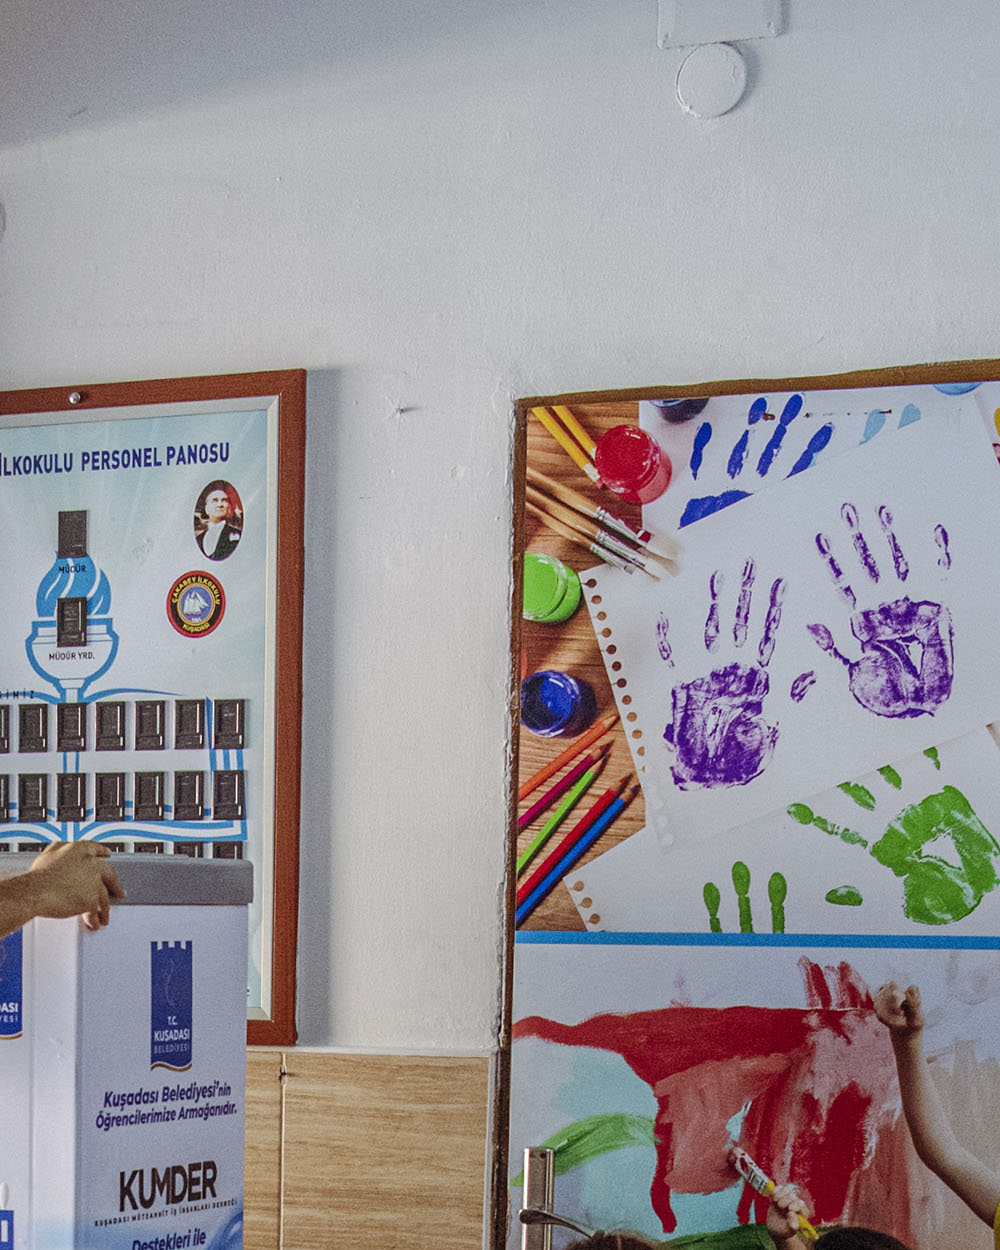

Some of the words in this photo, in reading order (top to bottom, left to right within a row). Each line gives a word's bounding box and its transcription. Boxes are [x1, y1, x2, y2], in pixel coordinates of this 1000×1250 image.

[81, 447, 163, 471] PERSONEL
[166, 442, 230, 466] PANOSU
[58, 564, 87, 574] MÜDÜR
[171, 576, 197, 603] ÇAKABEY
[48, 651, 77, 661] MÜDÜR
[77, 651, 96, 661] YRD.
[153, 1028, 191, 1043] KUŞADASI
[103, 1087, 160, 1112] Kuşadası
[95, 1106, 177, 1132] Öğrencilerimize
[177, 1100, 238, 1121] Armağanıdır.
[119, 1159, 218, 1213] KUMDER
[94, 1216, 130, 1228] KUŞADASI
[192, 1228, 207, 1247] ile
